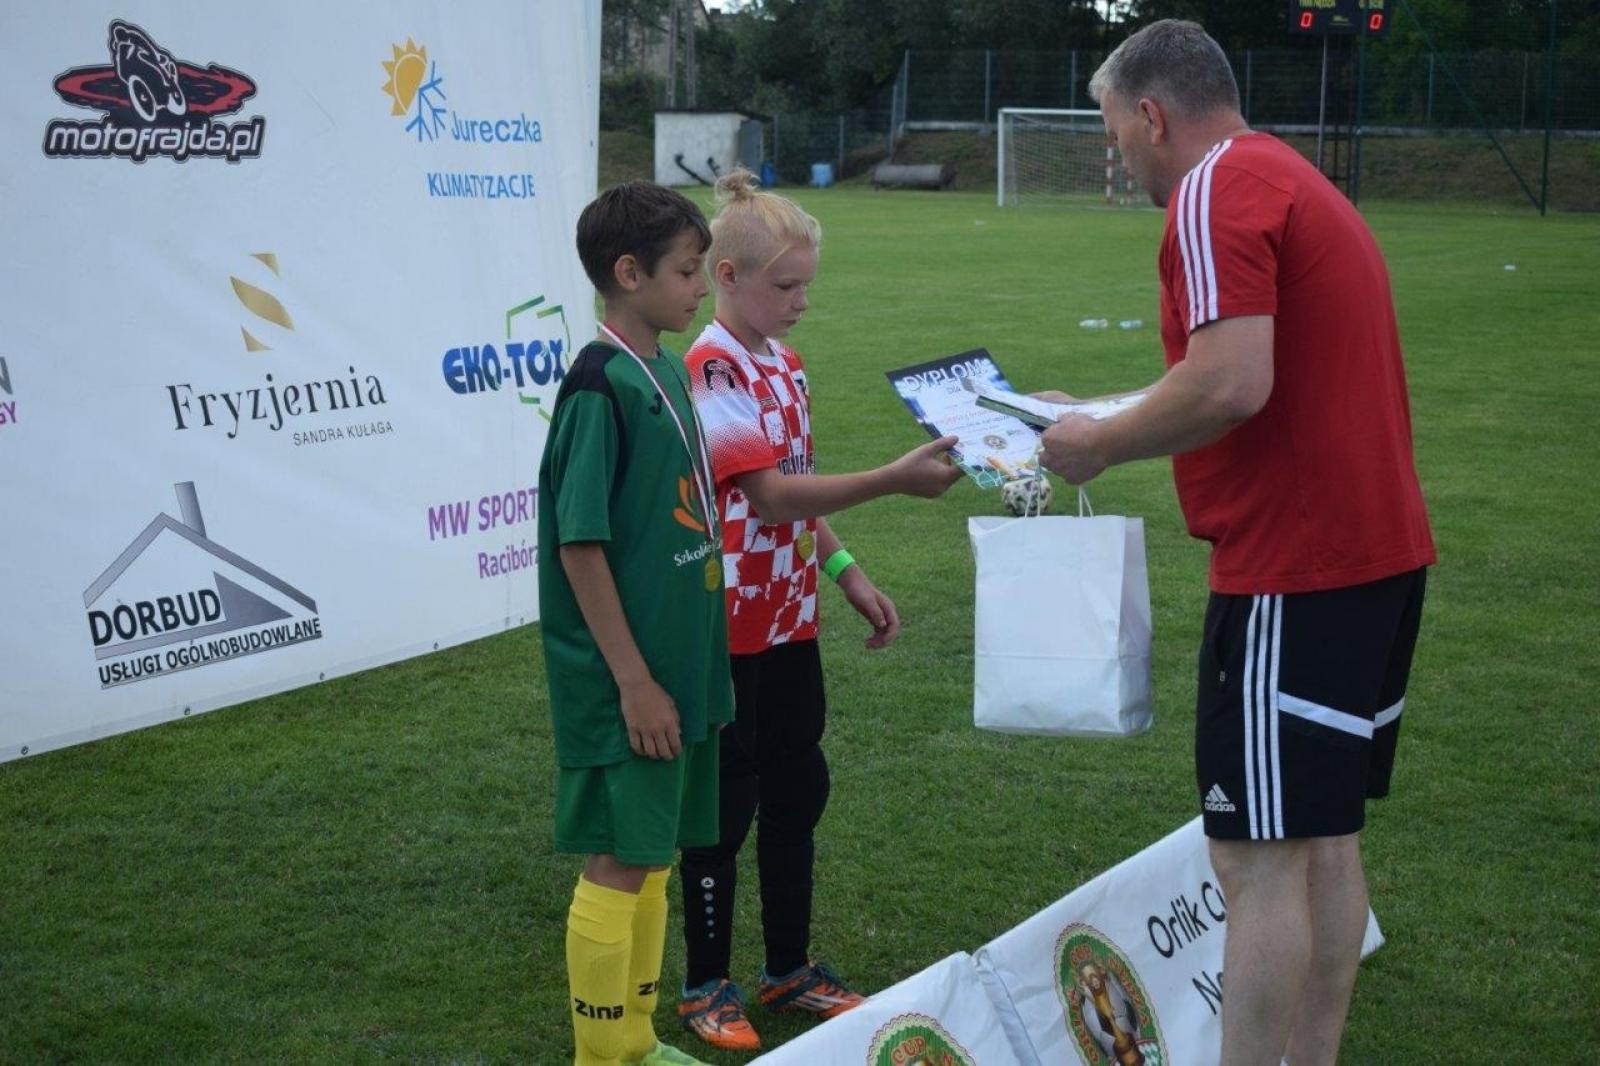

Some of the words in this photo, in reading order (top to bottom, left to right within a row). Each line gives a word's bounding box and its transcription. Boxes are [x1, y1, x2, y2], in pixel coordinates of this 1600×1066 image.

[1299, 11, 1313, 28] 0
[1368, 13, 1383, 30] 0
[49, 121, 261, 156] motofrajda.pl
[451, 110, 543, 143] Jureczka
[426, 172, 536, 199] KLIMATYZACJE
[442, 338, 565, 394] EKO-TOX
[902, 357, 982, 391] DYPLOM
[165, 365, 388, 440] Fryzjernia
[292, 427, 344, 447] SANDRA
[428, 500, 471, 541] MW
[478, 487, 539, 531] SPORT
[88, 589, 221, 646] DORBUD
[99, 653, 163, 685] USŁUGI
[165, 617, 323, 669] OGÓLNOBUDOWLANE
[1204, 802, 1236, 812] adidas
[1147, 893, 1209, 958] Orlik
